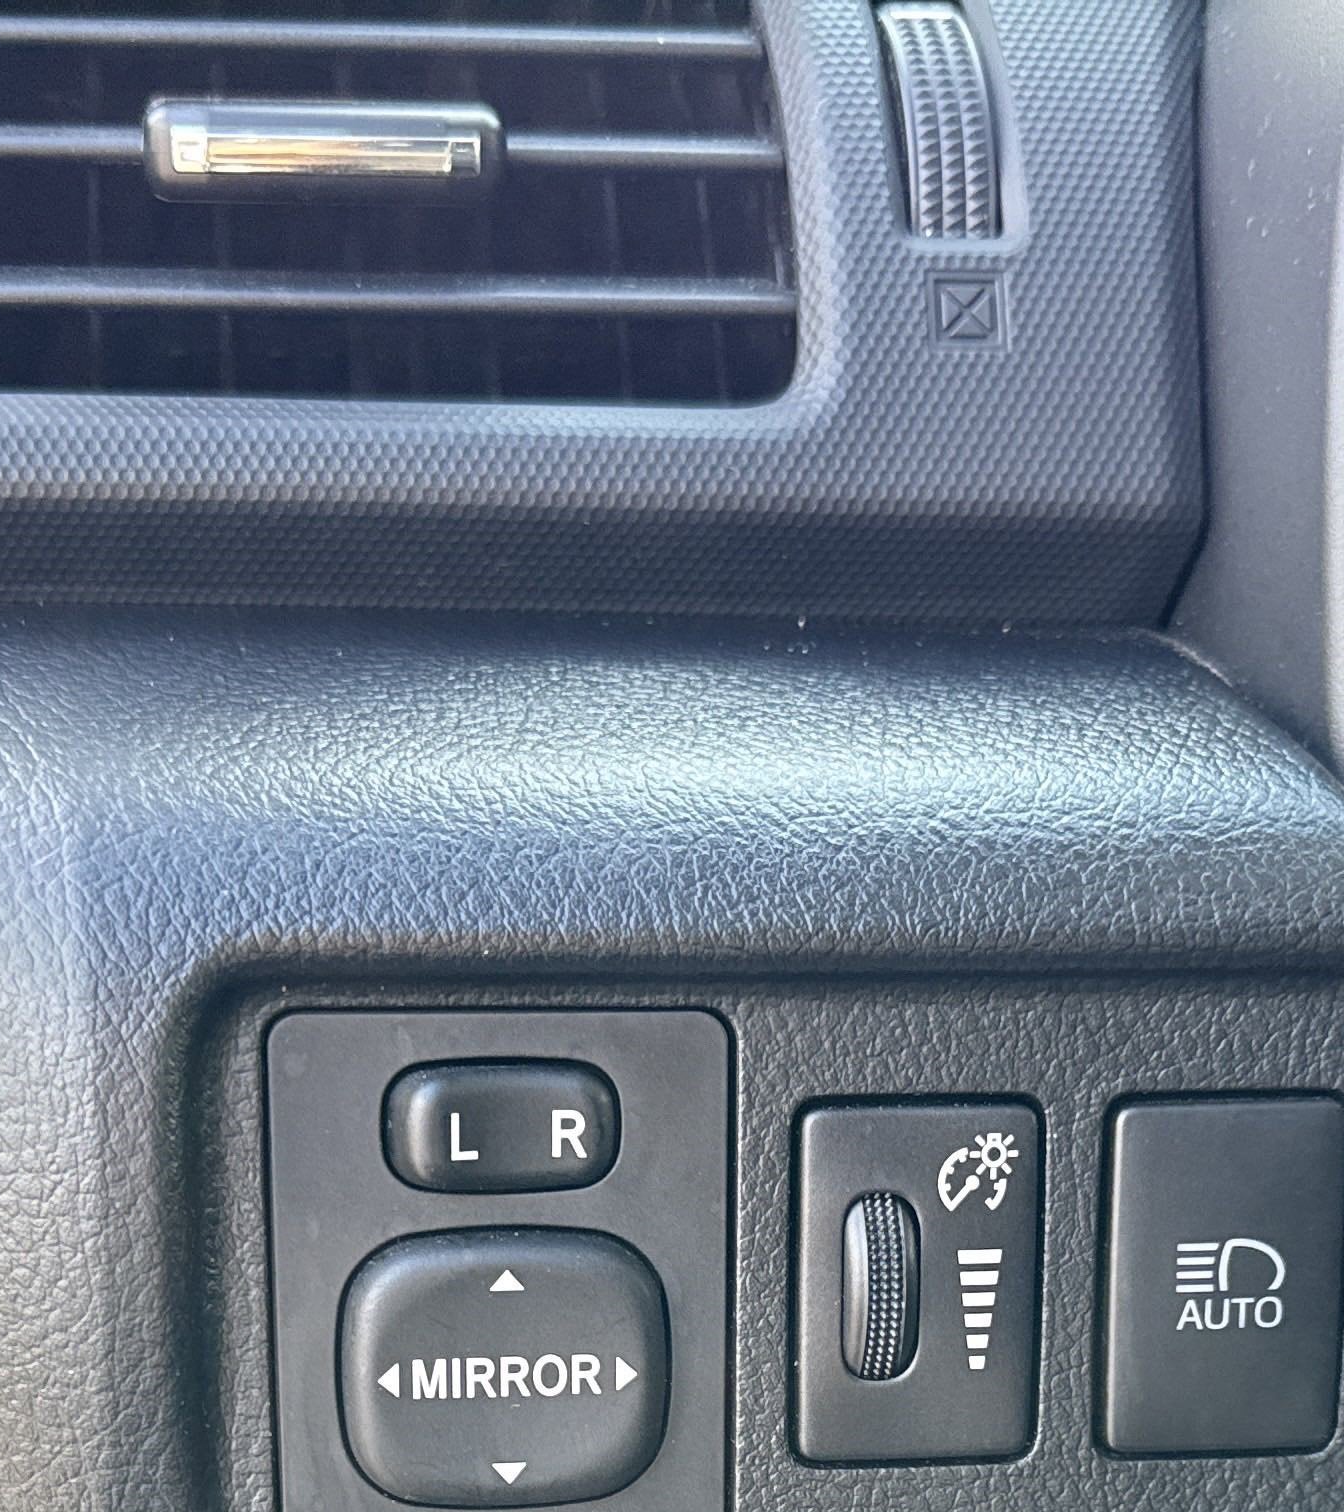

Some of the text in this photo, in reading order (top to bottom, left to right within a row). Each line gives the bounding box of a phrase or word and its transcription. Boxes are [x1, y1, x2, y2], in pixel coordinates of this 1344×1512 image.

[450, 1109, 588, 1162] L R
[1175, 1296, 1283, 1331] AUTO
[411, 1353, 602, 1399] MIRROR
